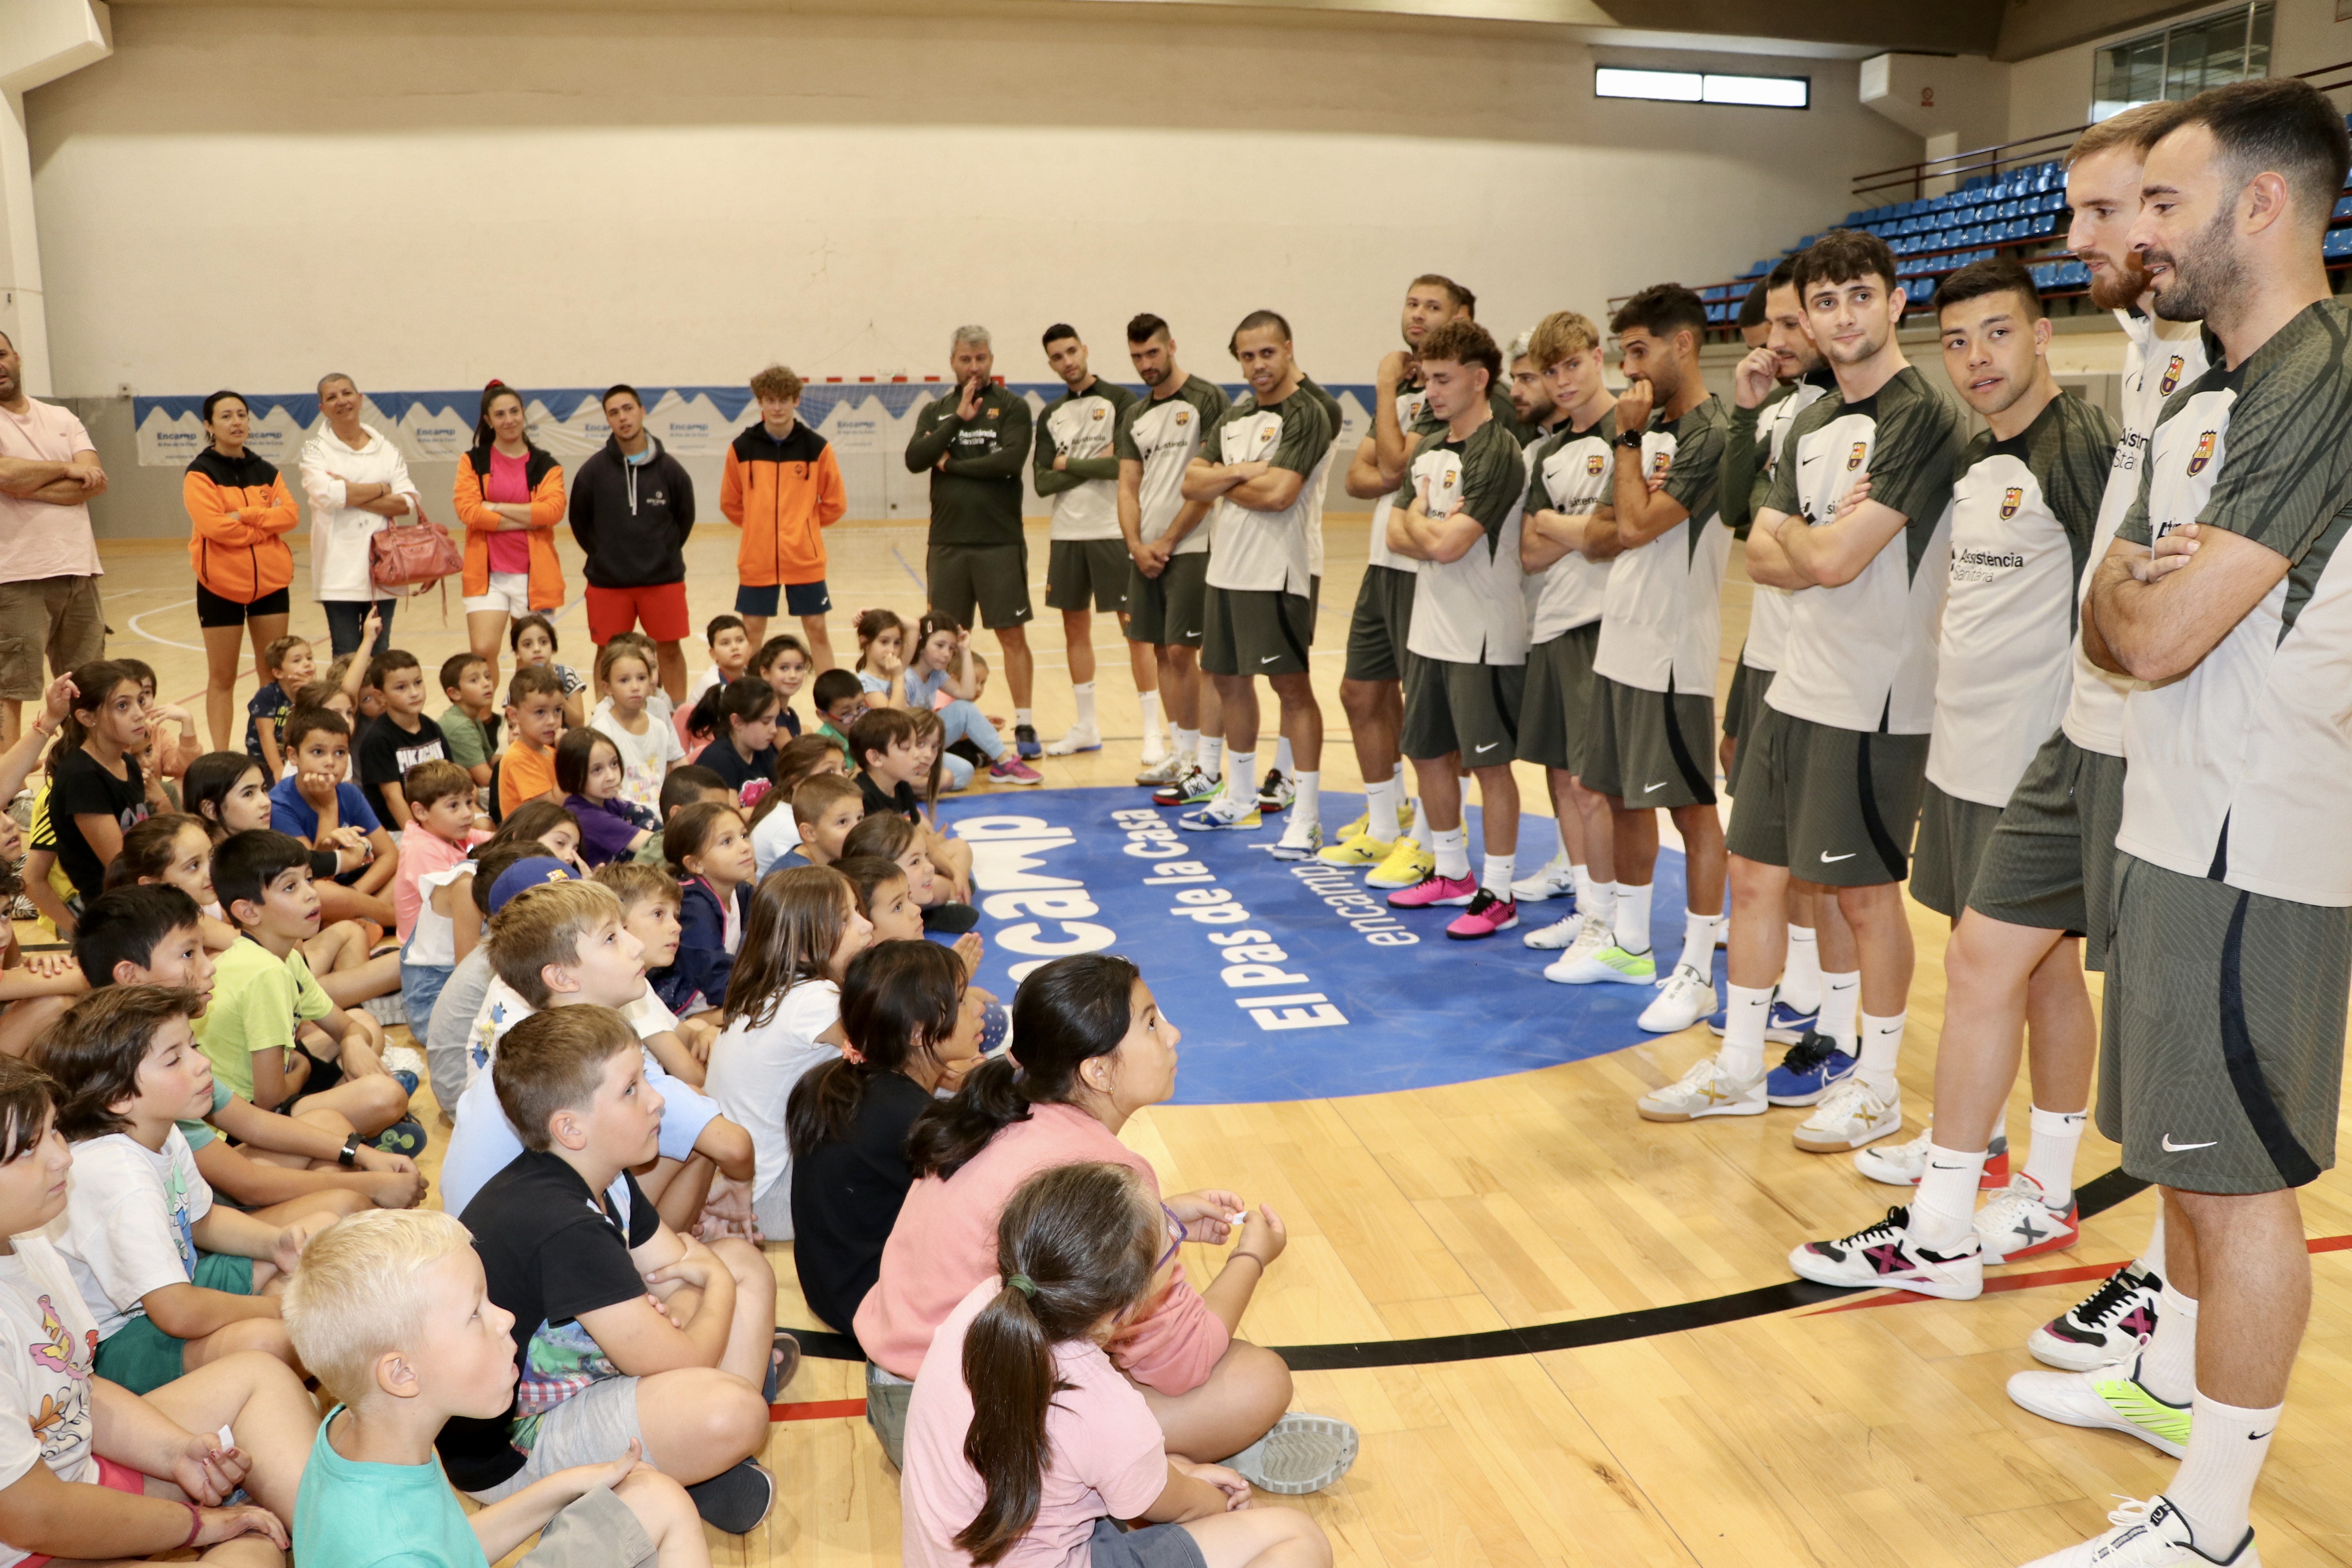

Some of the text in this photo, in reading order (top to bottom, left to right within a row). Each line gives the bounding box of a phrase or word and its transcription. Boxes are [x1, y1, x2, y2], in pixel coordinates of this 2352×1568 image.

[1960, 548, 2024, 567] Assistència
[1143, 861, 1216, 885] la
[1170, 888, 1250, 924] de
[1235, 992, 1349, 1031] El
